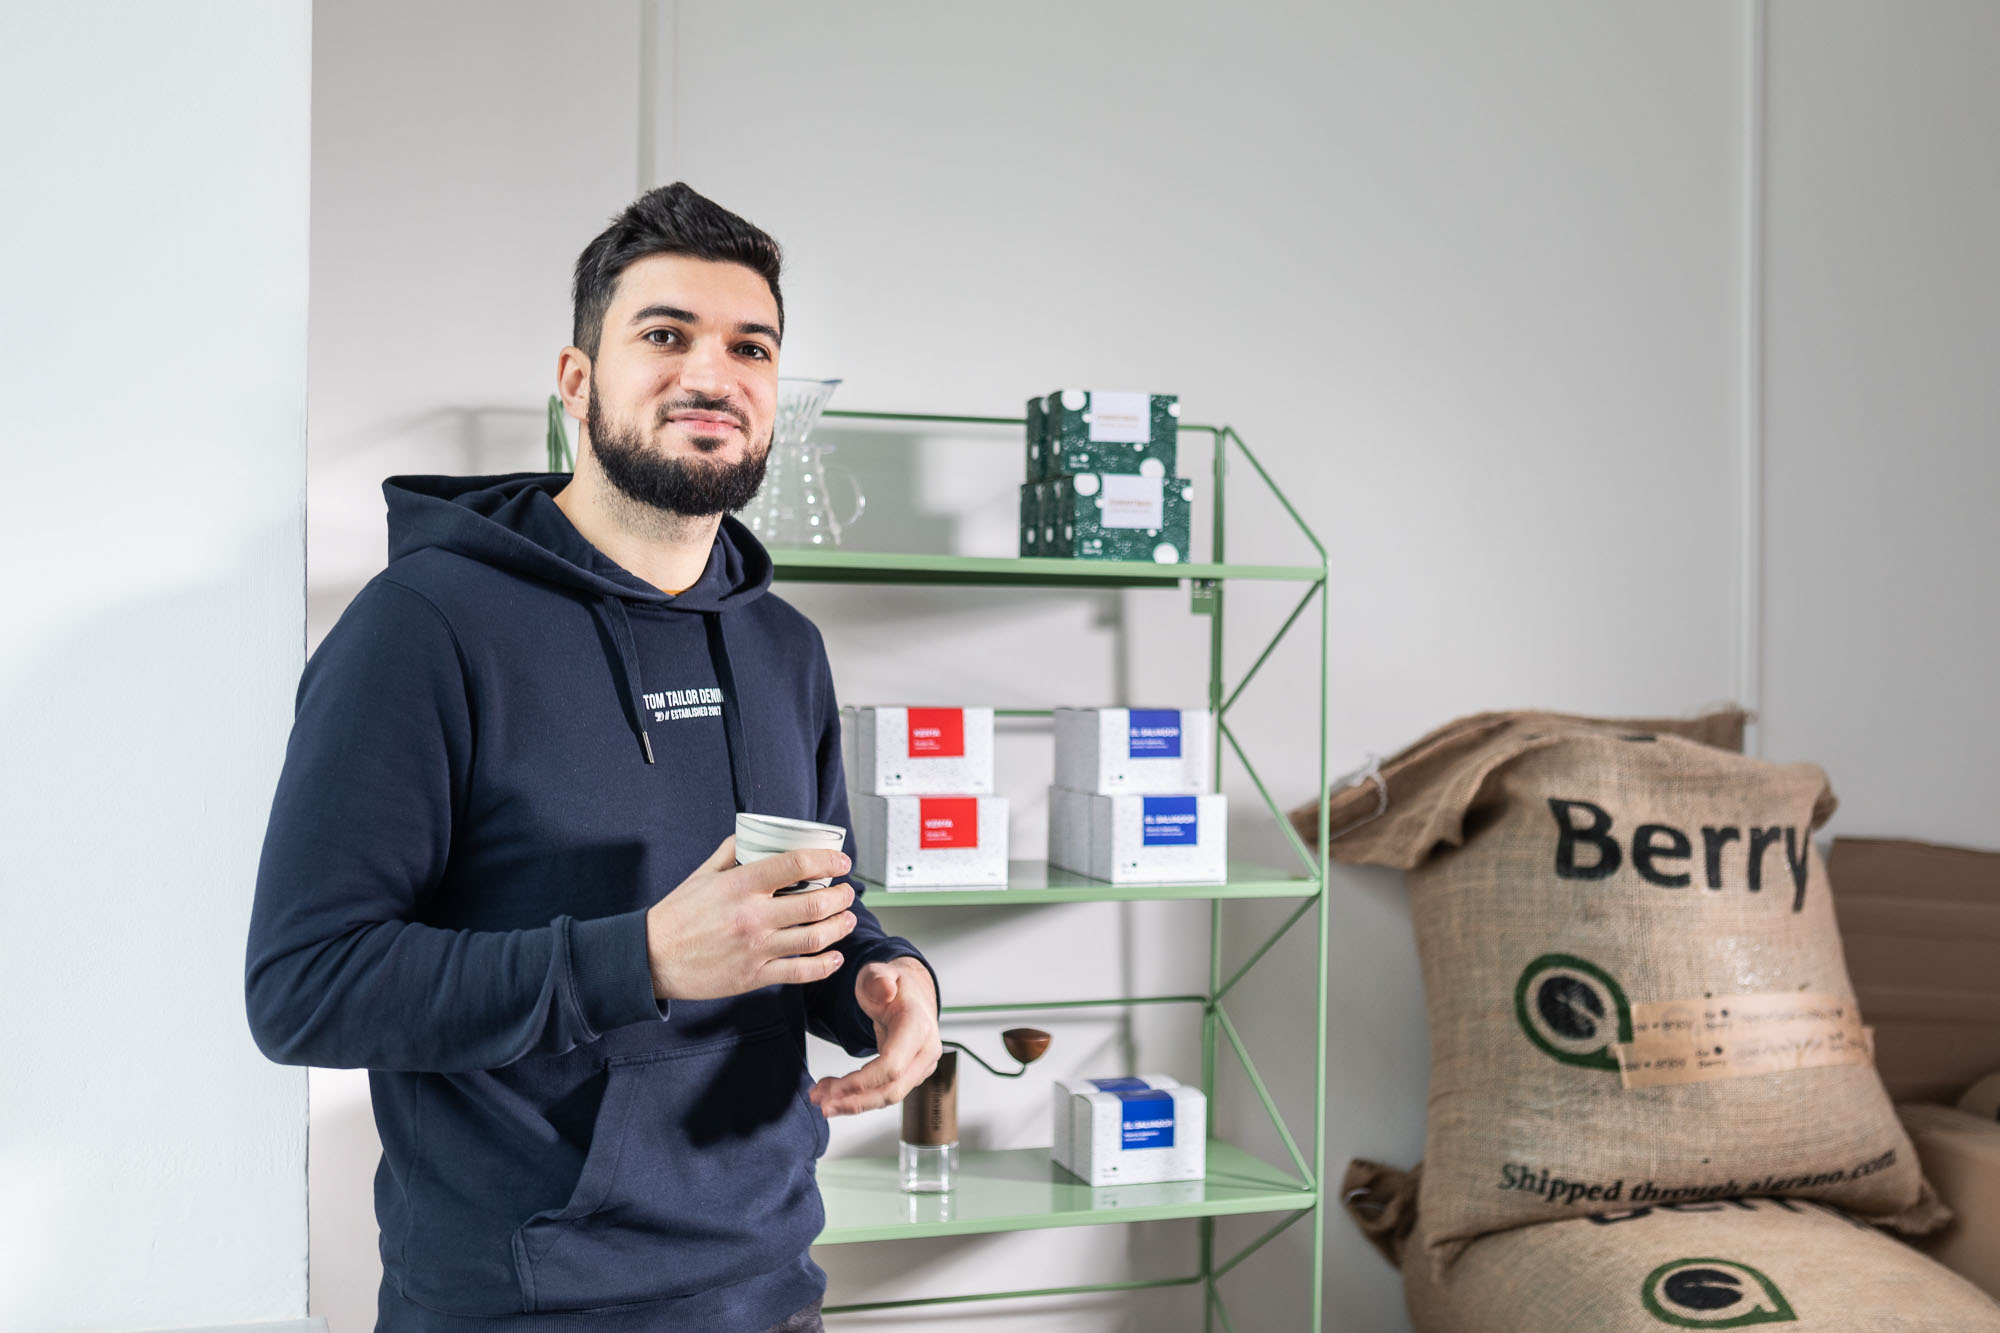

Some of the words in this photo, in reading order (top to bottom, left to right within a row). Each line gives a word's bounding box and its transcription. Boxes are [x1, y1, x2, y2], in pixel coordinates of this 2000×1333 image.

[643, 692, 666, 710] TOM
[665, 688, 700, 707] TAILOR
[671, 706, 708, 720] ESTABLISHED
[708, 705, 722, 717] 2007
[1547, 797, 1811, 914] Berry
[1497, 1162, 1625, 1205] Shipped
[1631, 1180, 1741, 1203] through
